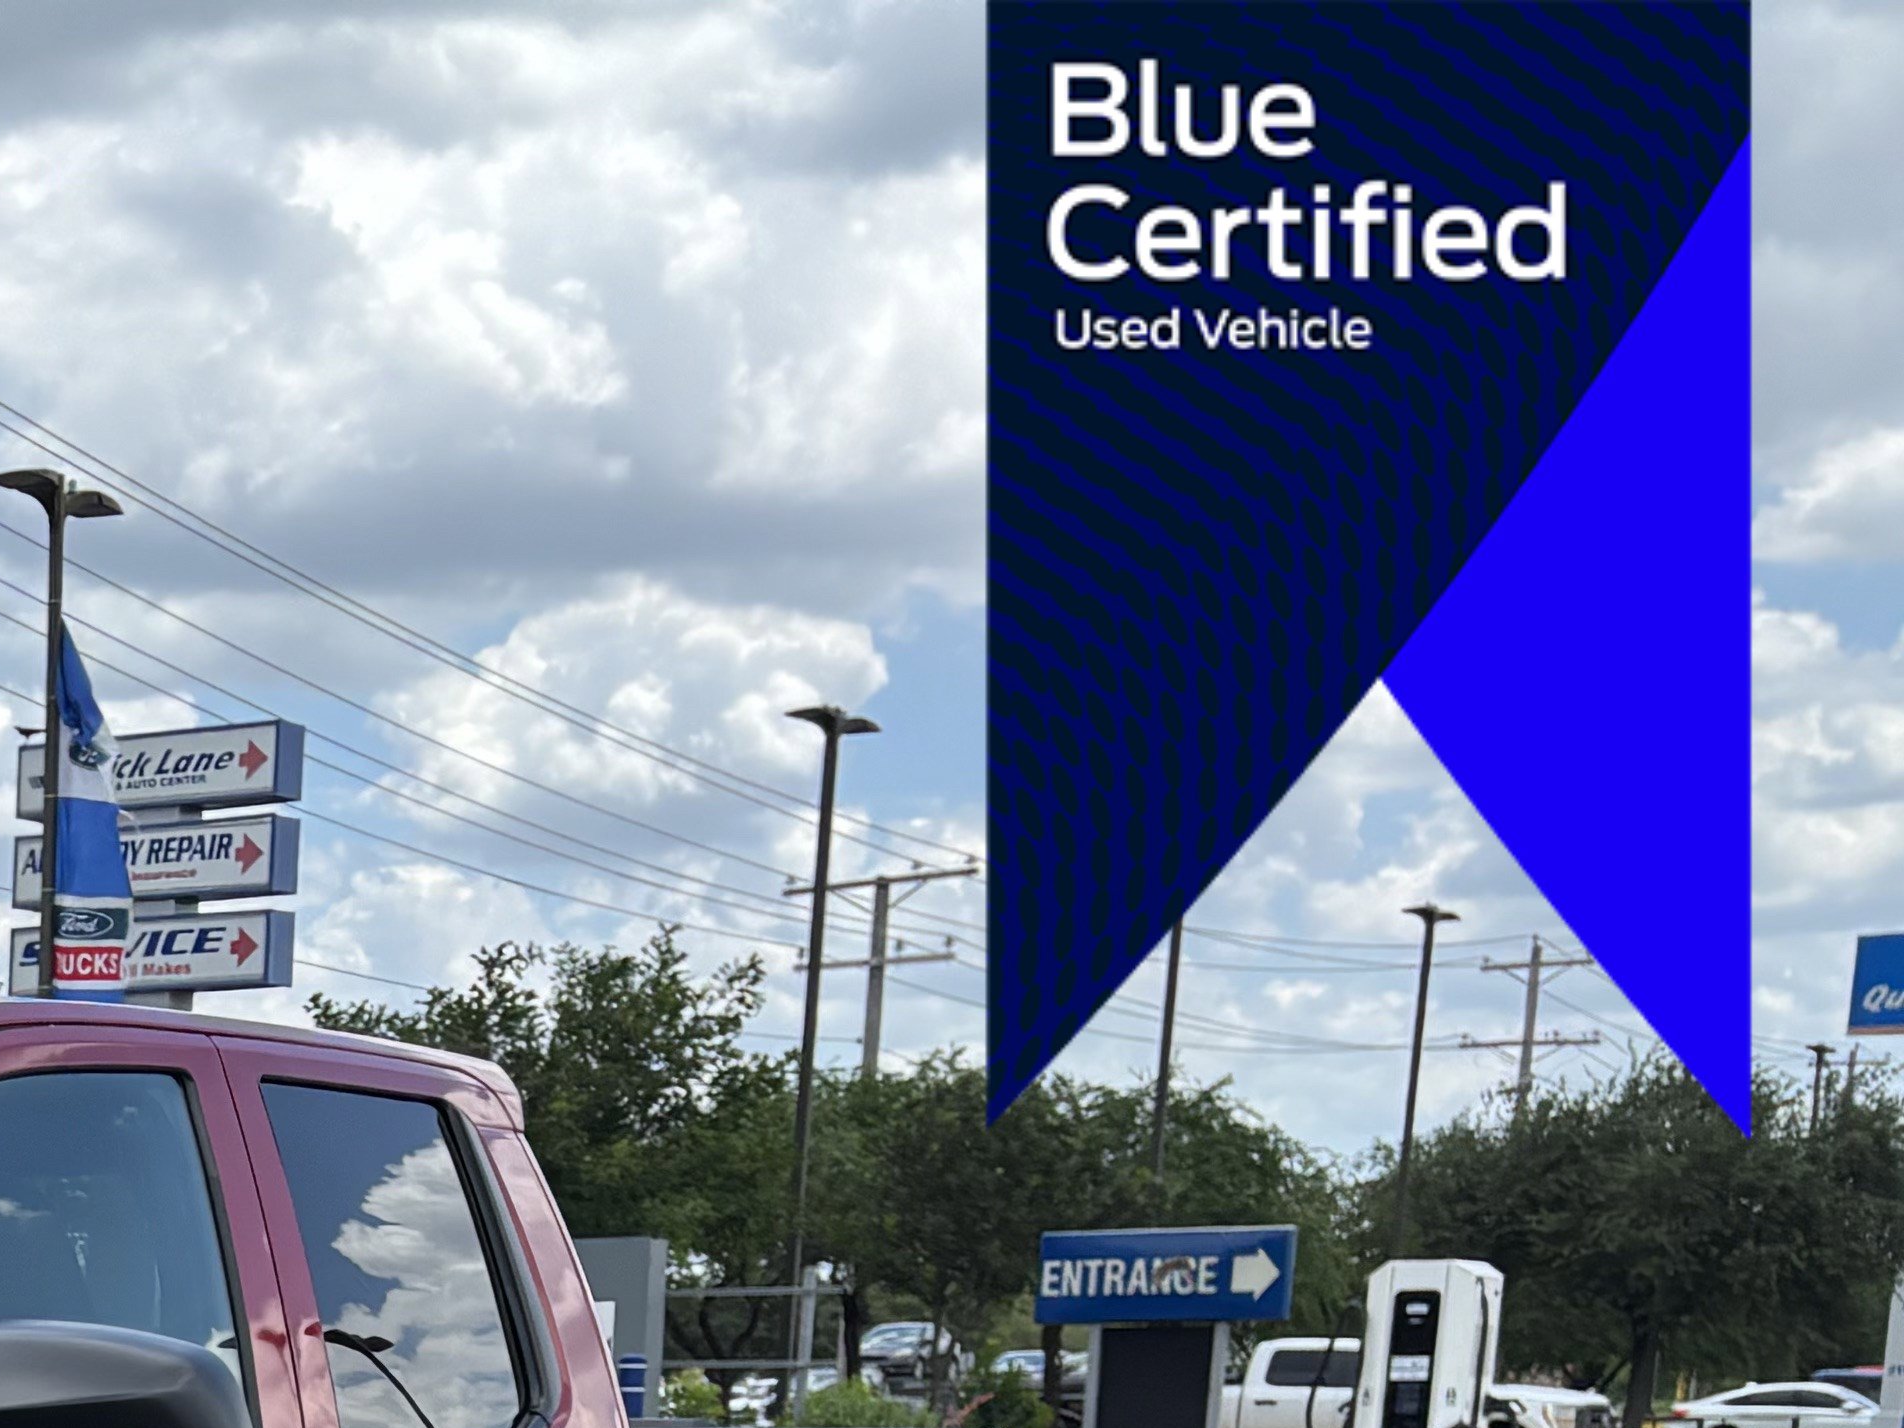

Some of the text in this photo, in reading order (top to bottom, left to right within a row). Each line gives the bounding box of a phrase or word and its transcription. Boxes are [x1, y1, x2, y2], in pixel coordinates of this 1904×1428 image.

[155, 748, 235, 779] Lane
[125, 778, 159, 791] AUTO
[160, 774, 207, 788] CENTER
[146, 833, 233, 866] REPAIR
[56, 952, 120, 975] UCKS
[1041, 1255, 1220, 1298] ENTRANCE
